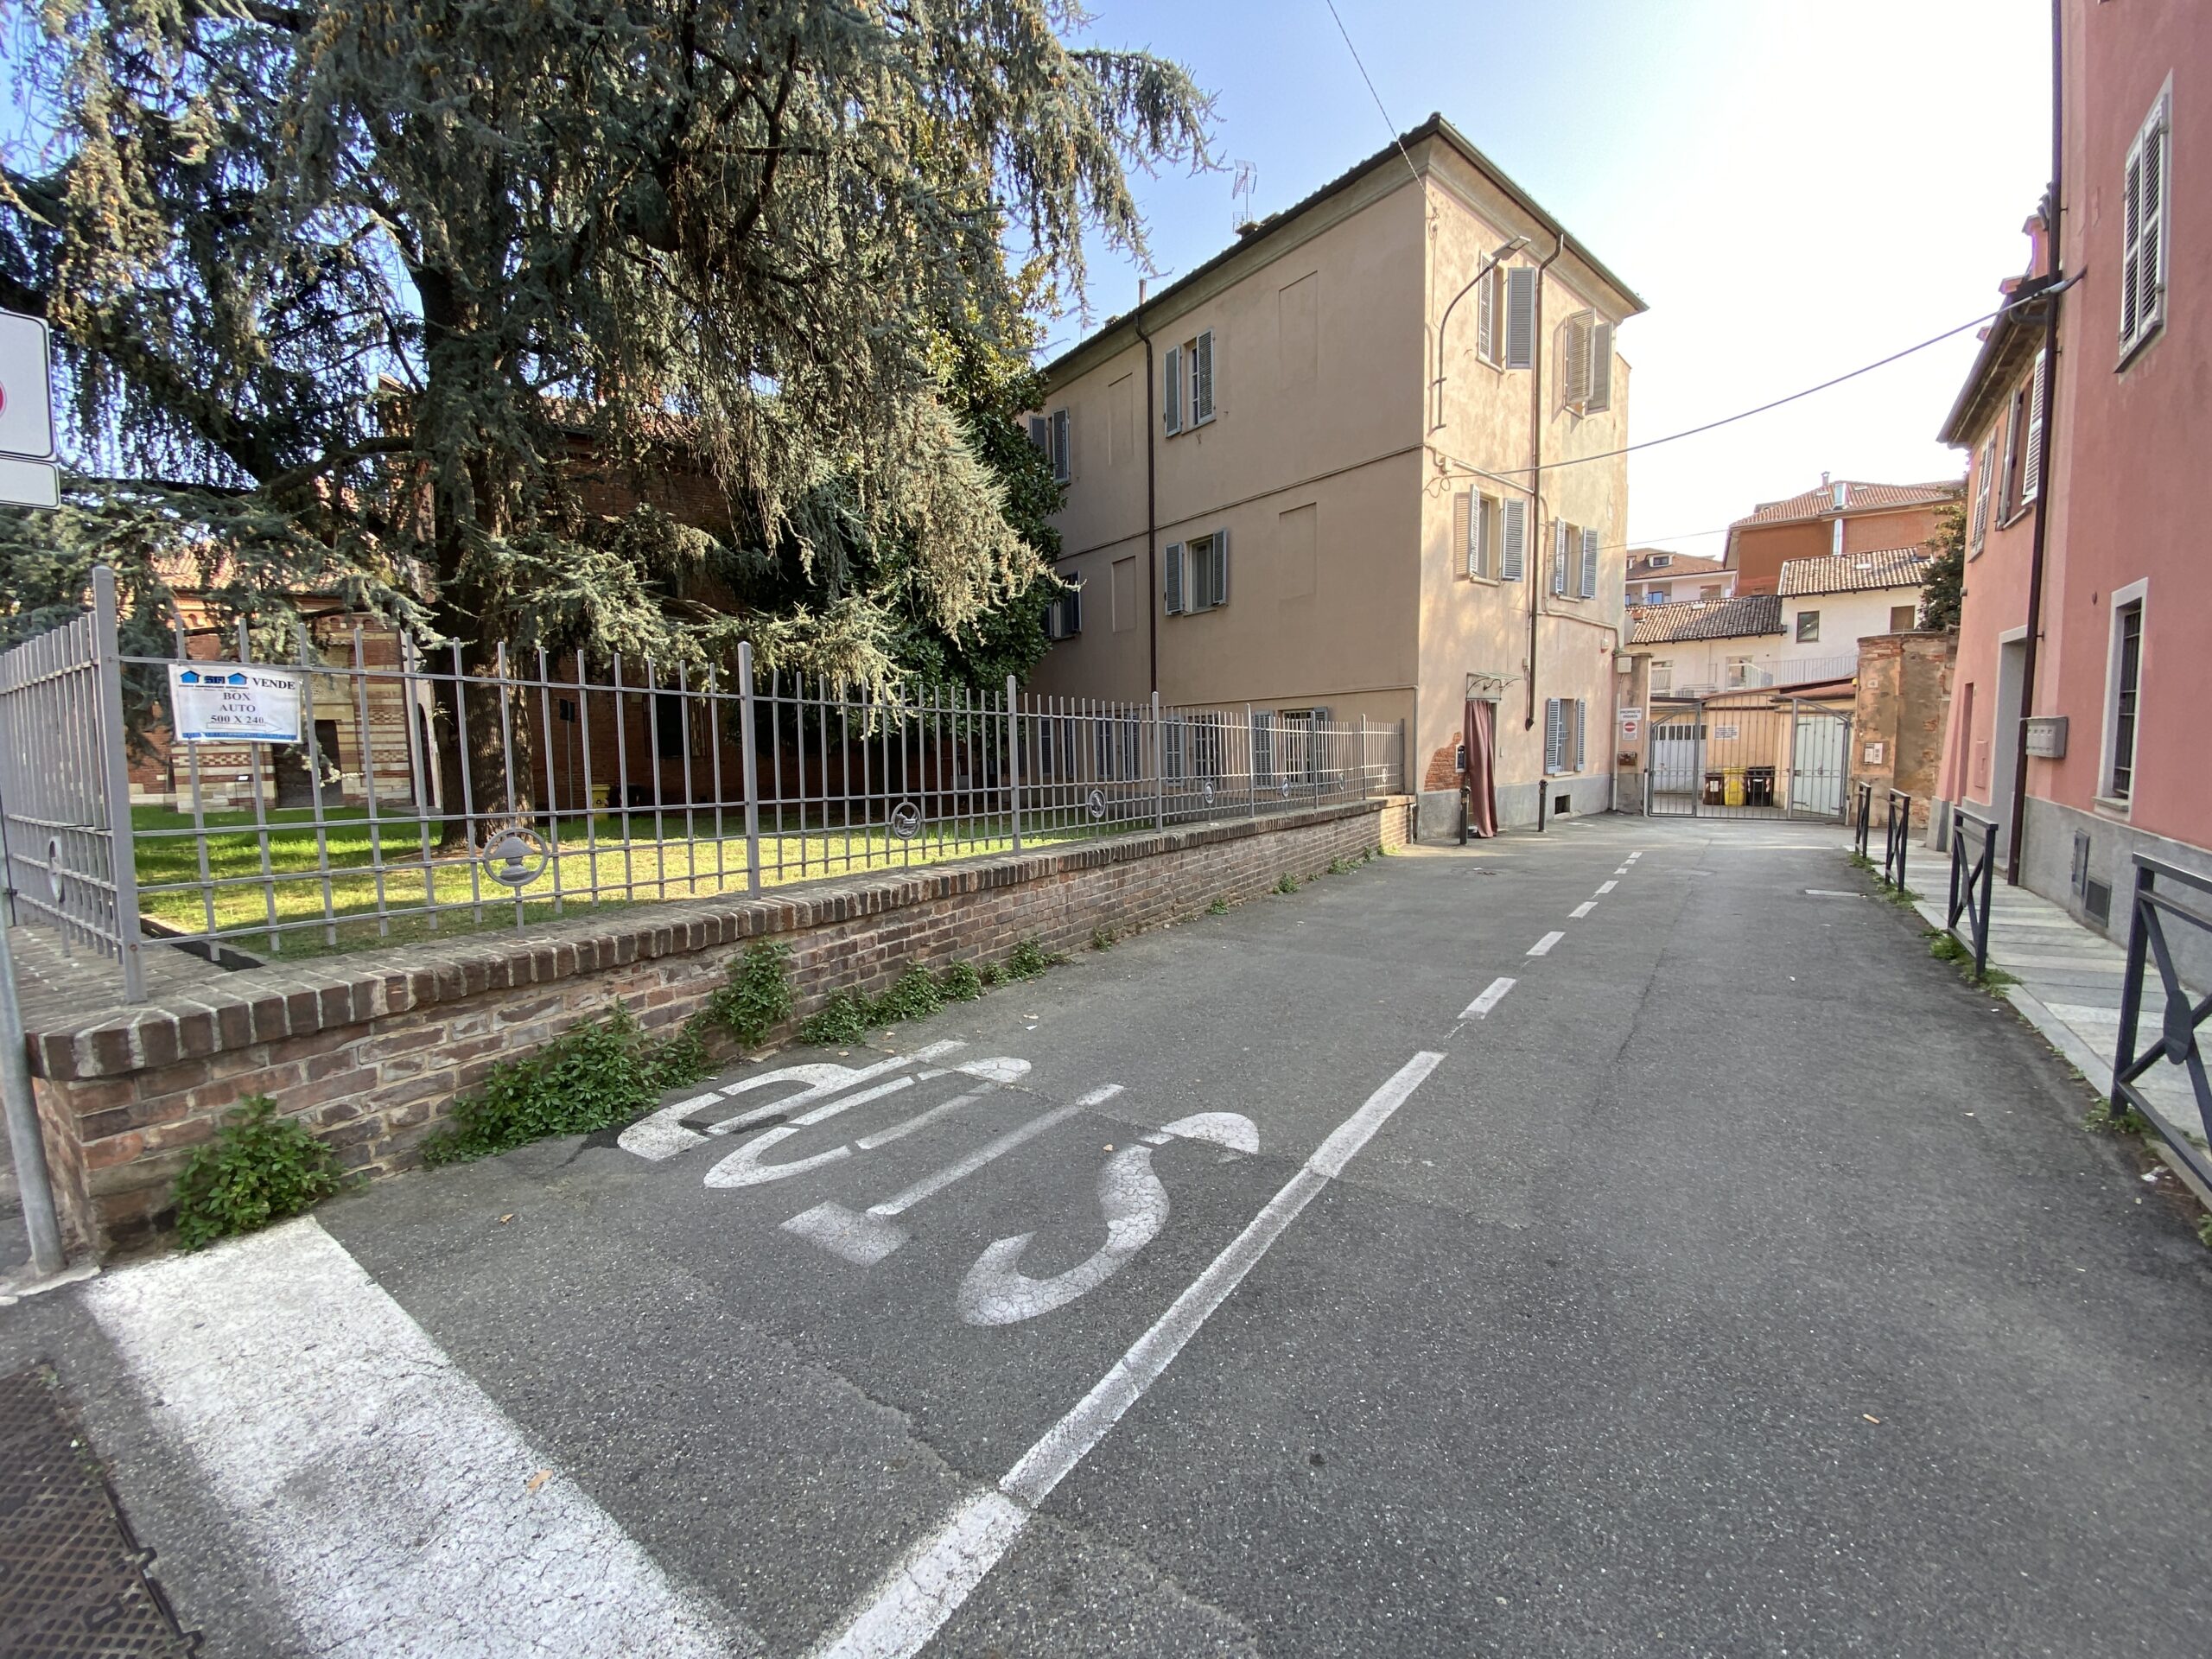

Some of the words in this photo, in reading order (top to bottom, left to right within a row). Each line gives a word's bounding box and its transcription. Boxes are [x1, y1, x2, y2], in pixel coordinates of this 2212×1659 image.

[252, 677, 296, 690] VENDE
[223, 692, 251, 701] BOX
[210, 715, 231, 723] 500
[246, 715, 264, 724] 240
[616, 1039, 1260, 1326] STOP
